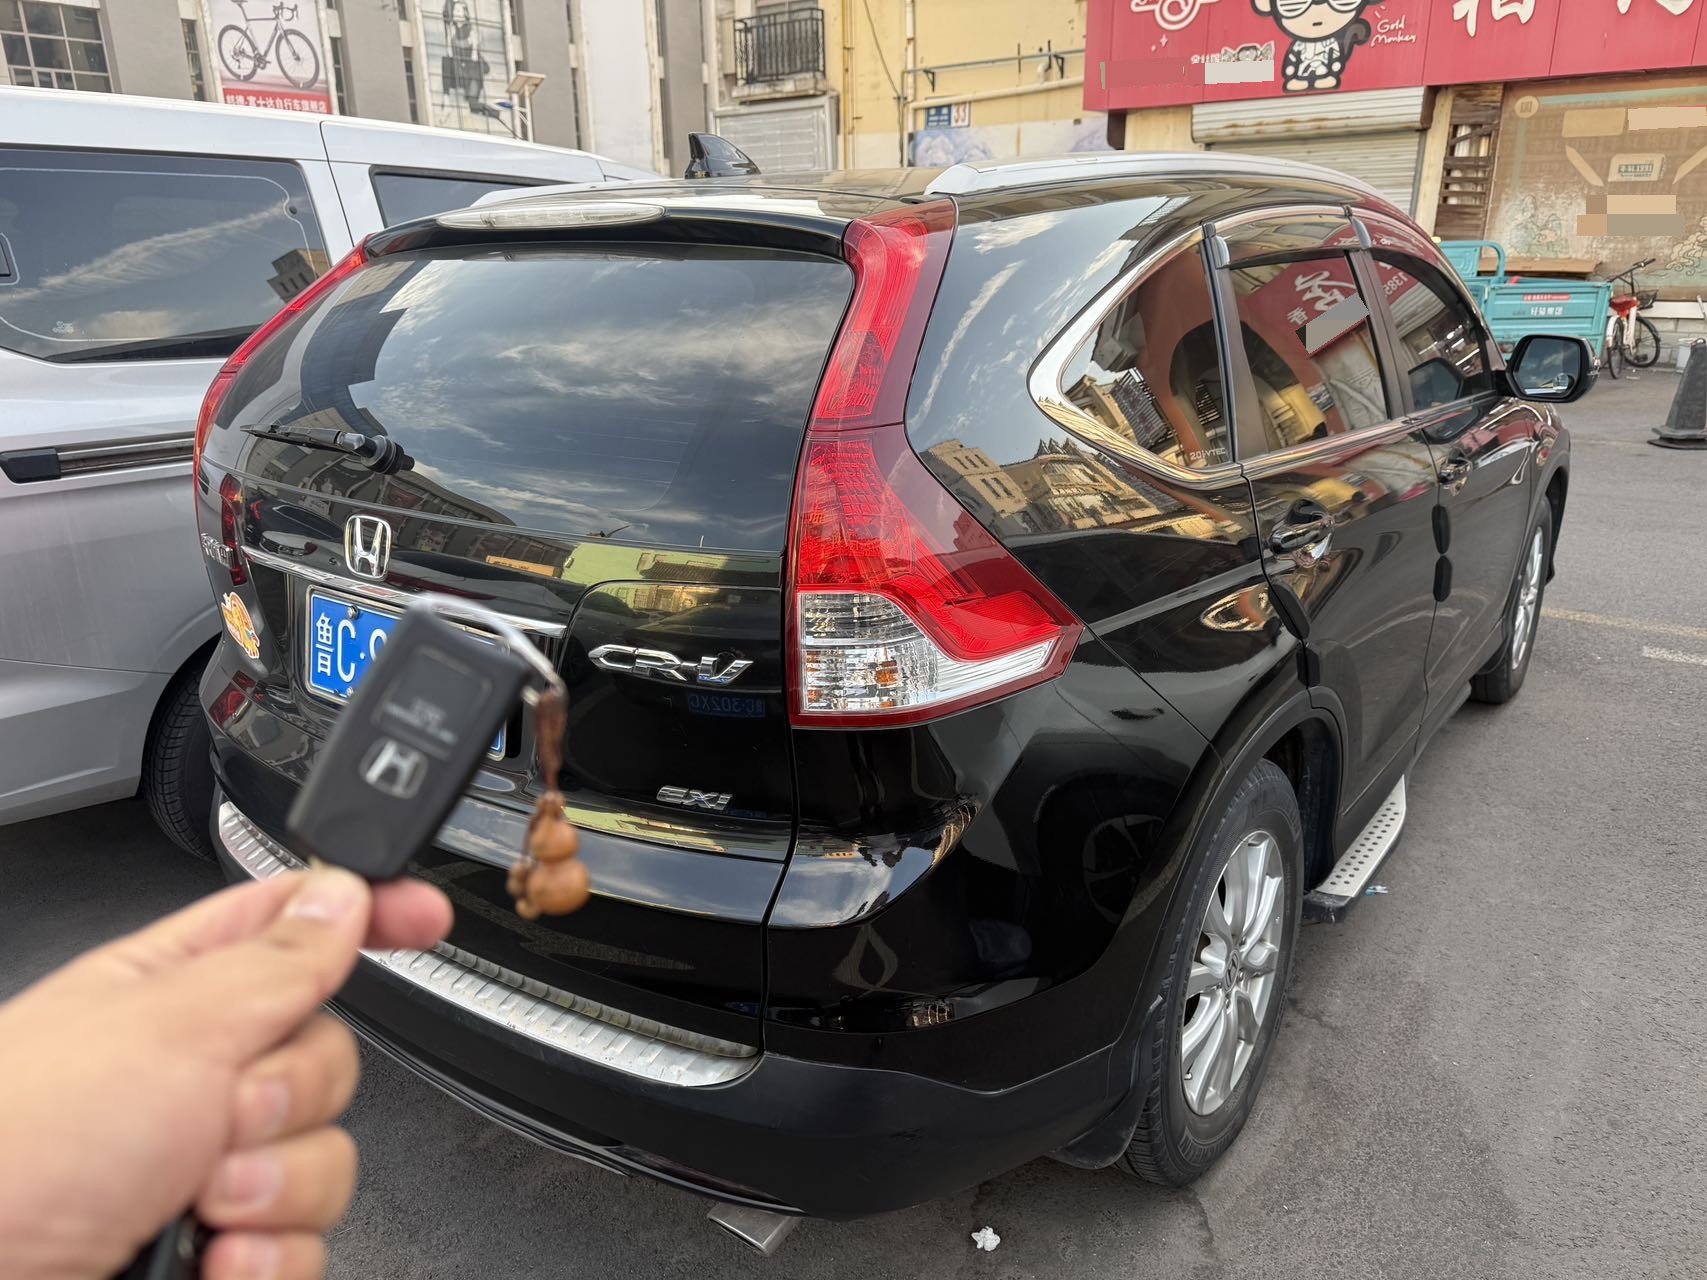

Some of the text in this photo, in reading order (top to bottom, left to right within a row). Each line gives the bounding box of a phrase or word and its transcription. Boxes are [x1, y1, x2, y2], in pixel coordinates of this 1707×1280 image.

[1377, 14, 1406, 33] Gold
[1370, 30, 1417, 48] Monkey
[588, 643, 754, 685] CR-V
